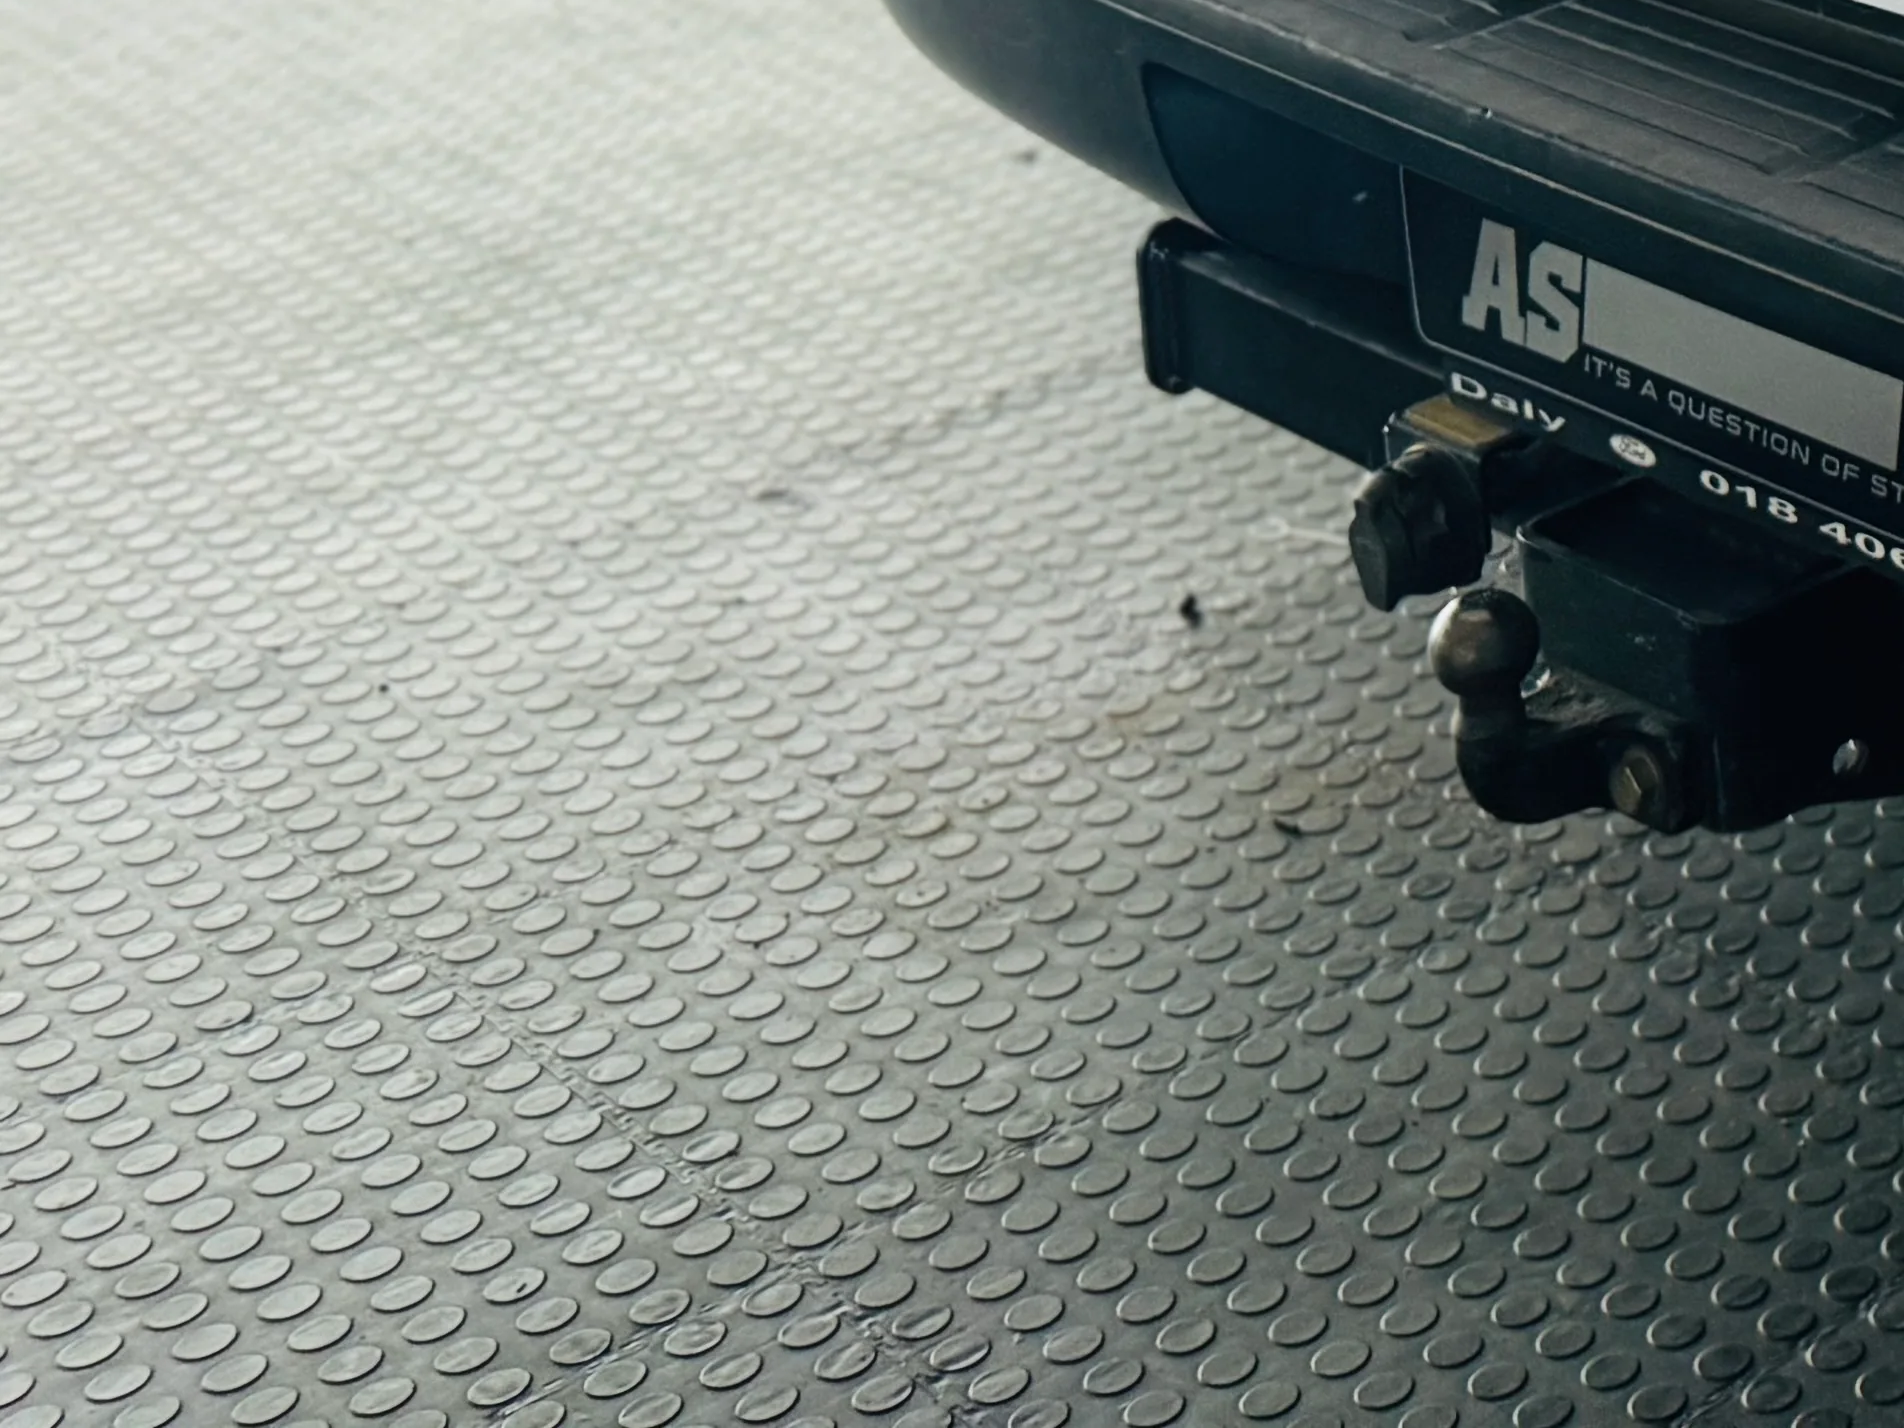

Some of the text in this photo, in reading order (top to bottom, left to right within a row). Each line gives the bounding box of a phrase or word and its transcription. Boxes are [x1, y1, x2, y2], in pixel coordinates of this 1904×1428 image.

[1462, 218, 1583, 363] AS
[1450, 373, 1566, 432] Daly
[1583, 354, 1632, 389] IT'S
[1640, 380, 1659, 401] A
[1667, 391, 1811, 462] QUESTION
[1822, 452, 1860, 483] OF
[1700, 468, 1799, 523] 018
